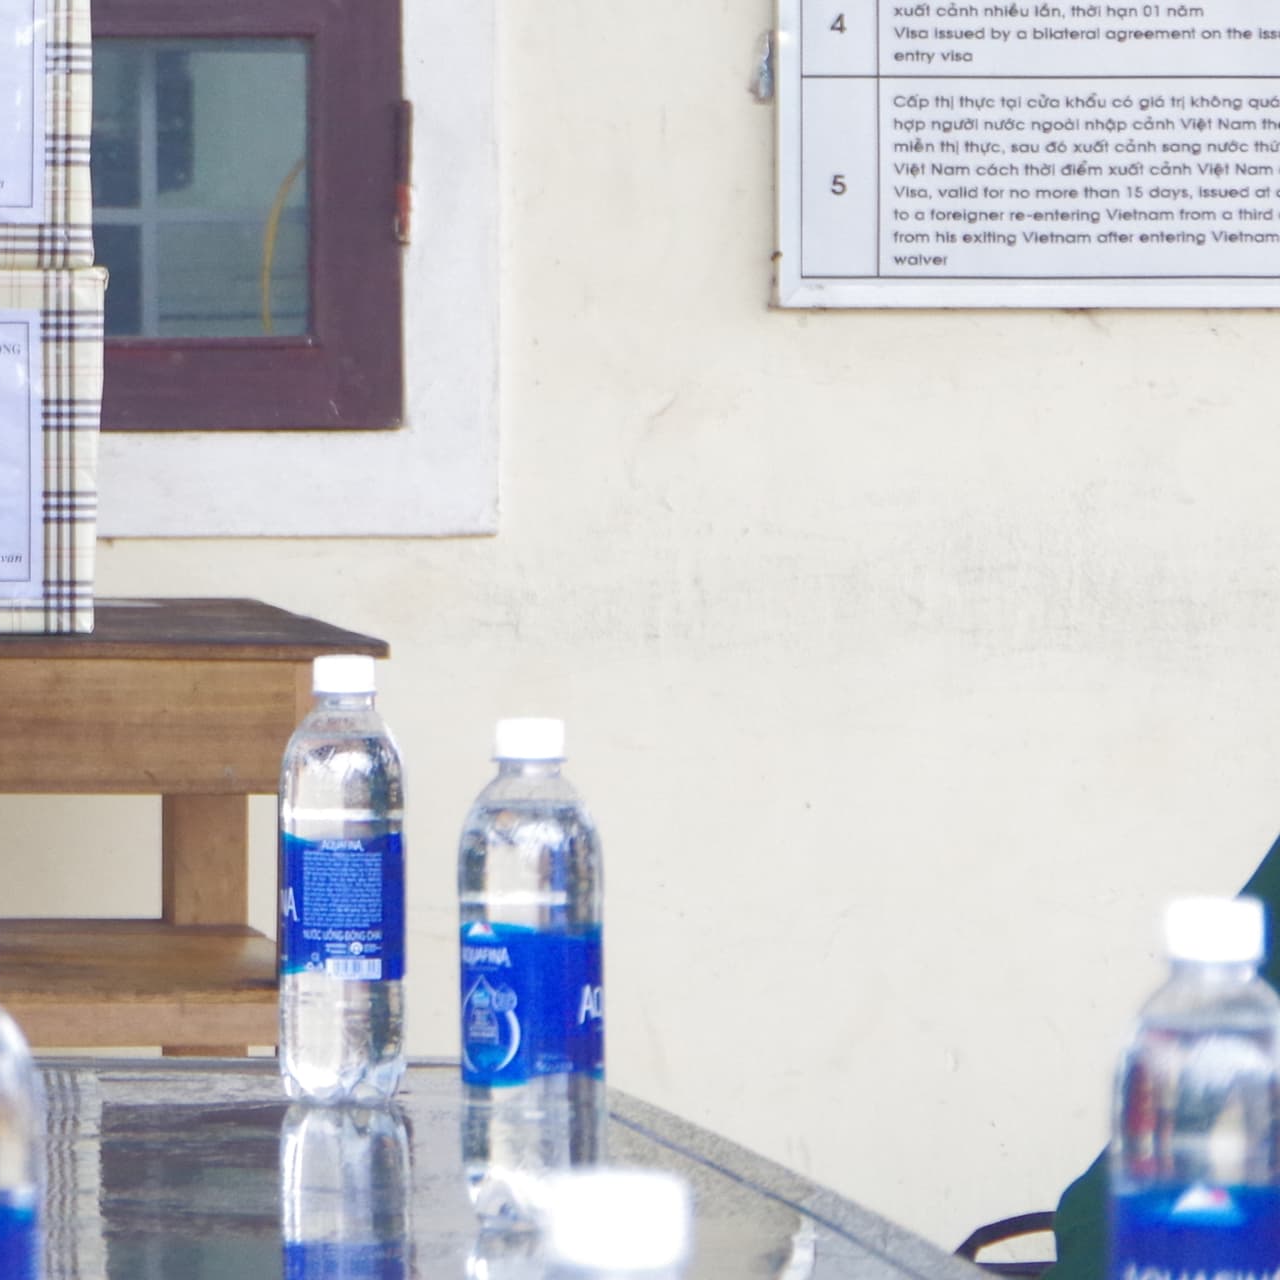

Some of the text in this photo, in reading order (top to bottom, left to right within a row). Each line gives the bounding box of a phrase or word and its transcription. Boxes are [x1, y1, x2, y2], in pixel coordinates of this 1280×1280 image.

[830, 13, 846, 33] 4
[893, 50, 973, 64] entry visa
[831, 174, 846, 195] 5
[894, 186, 1270, 200] Visa, valid for no more than 15 days, issued at
[893, 254, 948, 266] waiver
